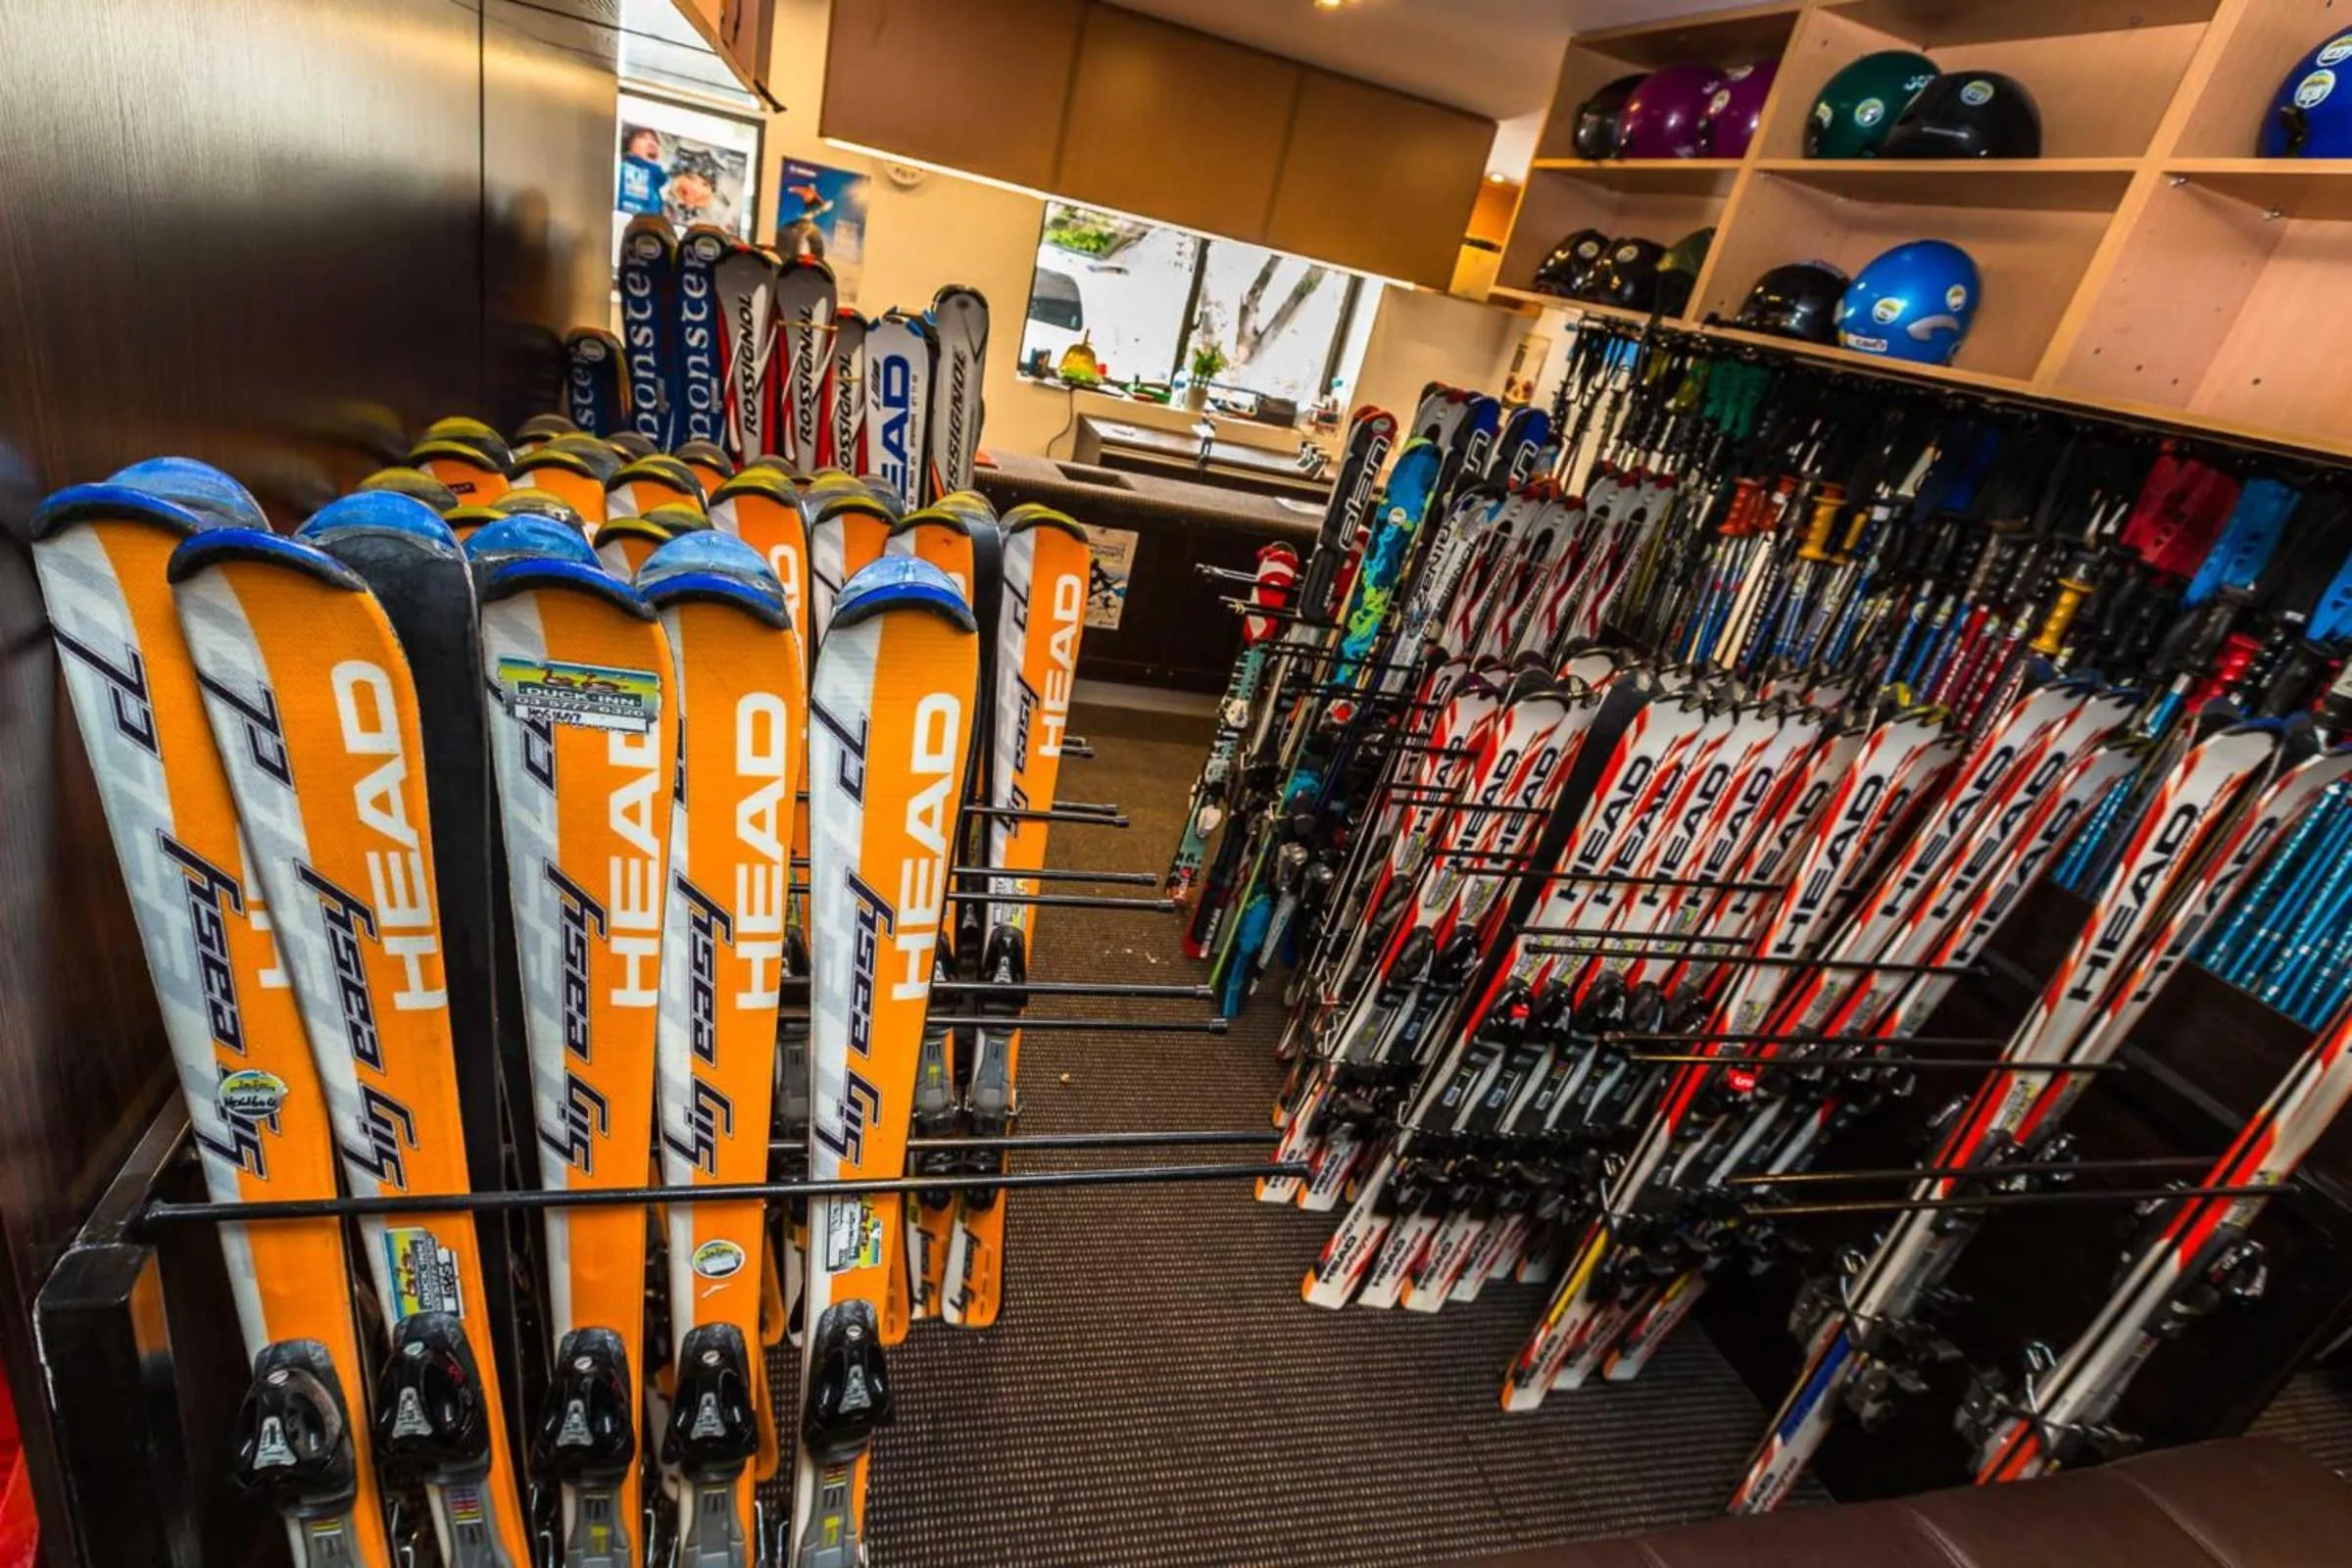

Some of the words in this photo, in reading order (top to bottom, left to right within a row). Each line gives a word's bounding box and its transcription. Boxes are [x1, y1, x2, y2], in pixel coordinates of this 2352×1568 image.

[737, 293, 758, 437] ROSSIGNOL
[799, 306, 813, 446] ROSSIGNOL
[838, 353, 853, 475] OSSIGNOL
[881, 354, 910, 506] EAD
[947, 350, 966, 493] OSSIGNOL
[526, 687, 588, 701] DUCK
[598, 694, 635, 707] INN
[1014, 673, 1040, 774] easy
[1038, 574, 1082, 758] HEAD
[330, 660, 447, 1010] HEAD
[609, 726, 662, 1008] HEAD
[735, 692, 786, 1010] HEAD
[893, 692, 960, 1002] HEAD
[1448, 749, 1519, 866] HEAD
[1490, 747, 1558, 864] HEAD
[1556, 756, 1653, 902] HEAD
[1641, 763, 1731, 906] HEAD
[1685, 766, 1774, 907] HEAD
[1731, 781, 1830, 913] HEAD
[1773, 774, 1886, 955] HEAD
[1881, 745, 2015, 917] HEAD
[1932, 751, 2067, 919] HEAD
[156, 828, 248, 1056] easy
[1951, 798, 2081, 962] HEAD
[2067, 804, 2198, 1004] HEAD
[2132, 816, 2278, 1003] HEAD
[293, 858, 385, 1074] easy
[544, 857, 609, 1066] easy
[673, 869, 735, 1067] easy
[845, 866, 895, 1059] easy
[341, 1084, 418, 1191] big
[539, 1071, 610, 1176] big
[662, 1073, 734, 1178] big
[815, 1071, 881, 1167] big
[1324, 1235, 1357, 1285] HEAD
[1373, 1238, 1405, 1287] HEAD
